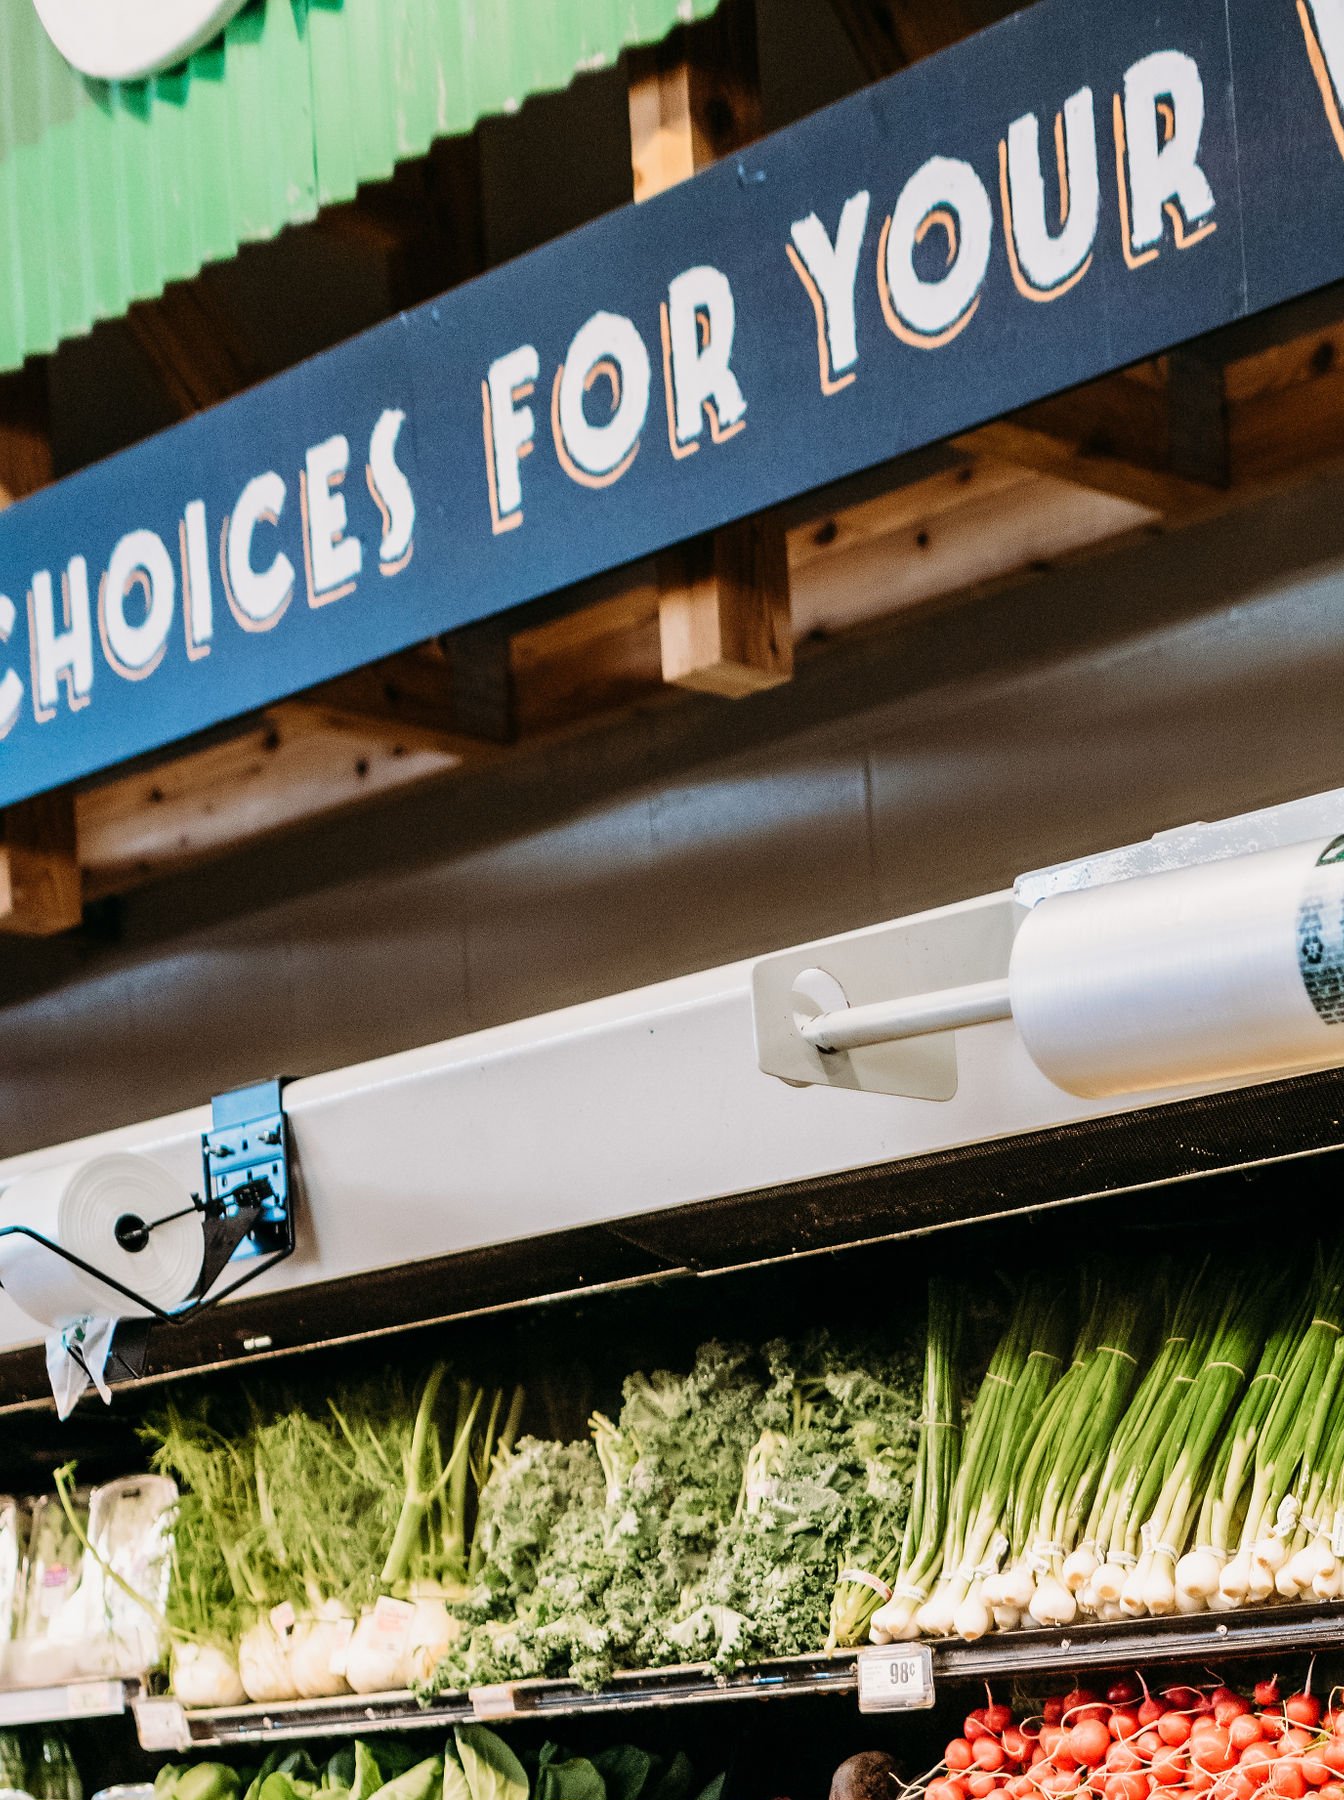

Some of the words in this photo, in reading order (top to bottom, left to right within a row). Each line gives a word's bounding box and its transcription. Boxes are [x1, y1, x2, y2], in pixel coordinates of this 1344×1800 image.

[483, 265, 747, 535] FOR
[786, 50, 1217, 396] YOUR
[890, 1662, 915, 1685] 98¢
